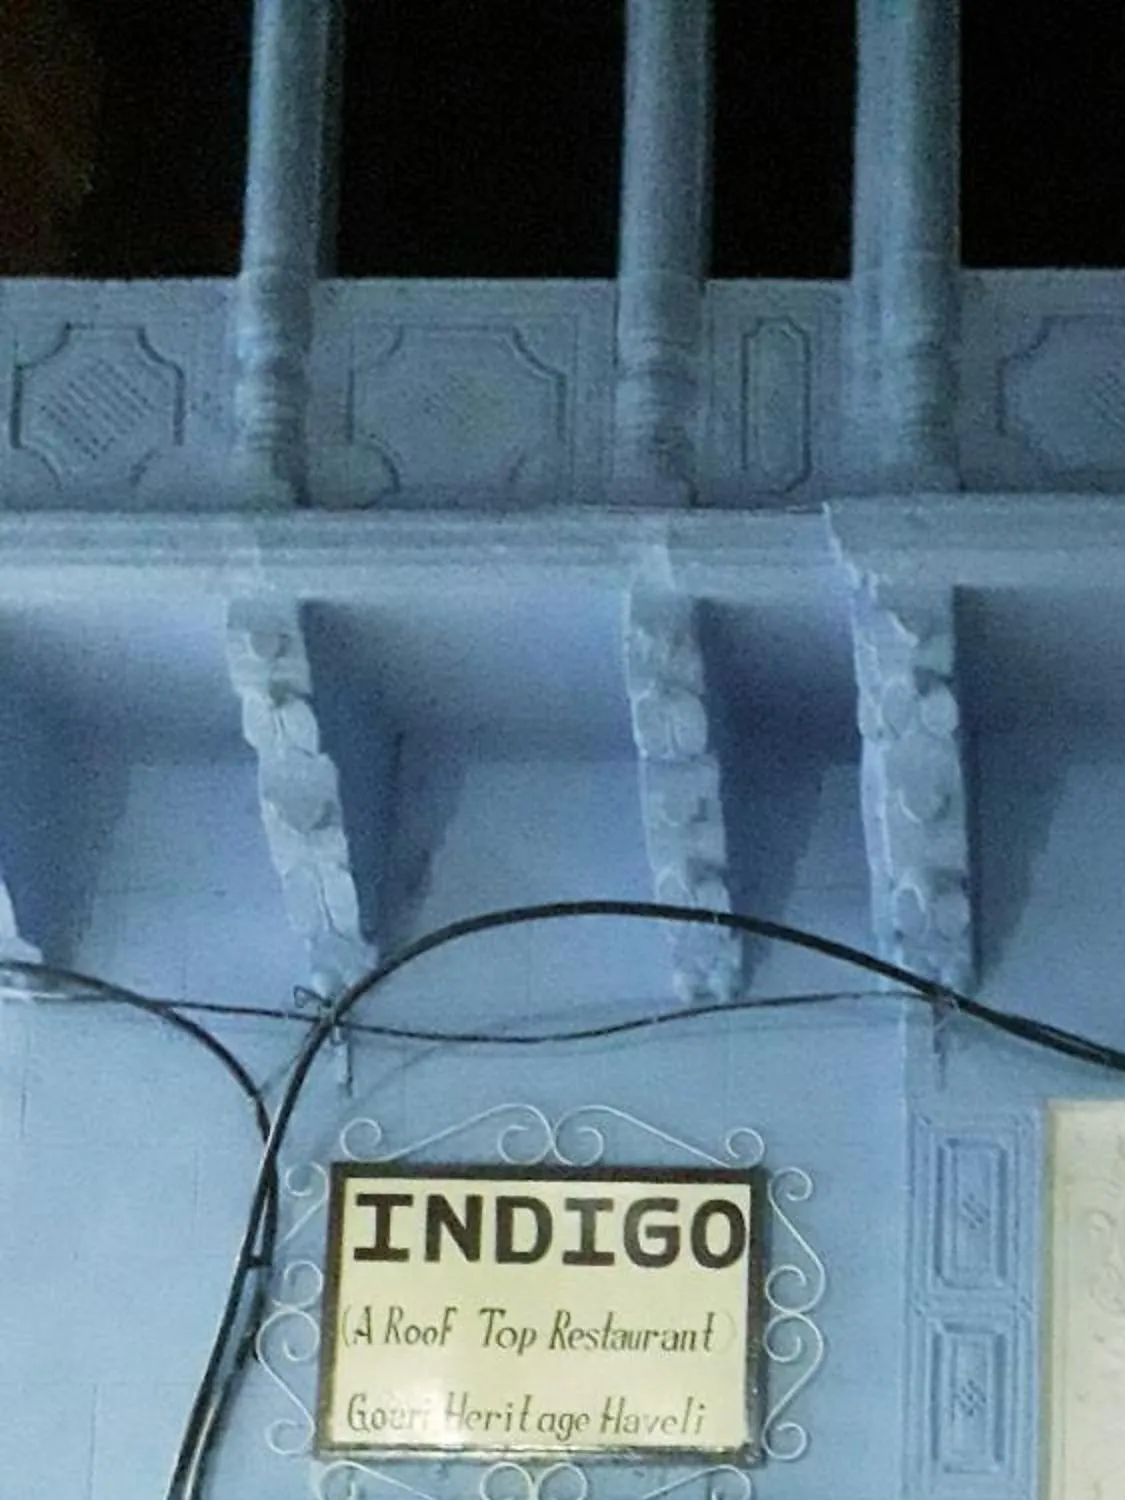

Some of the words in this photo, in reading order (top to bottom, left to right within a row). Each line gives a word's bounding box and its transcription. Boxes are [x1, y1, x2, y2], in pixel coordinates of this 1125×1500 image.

[353, 1192, 747, 1270] INDIGO
[479, 1307, 538, 1355] Top
[445, 1391, 590, 1440] Heritage
[600, 1396, 706, 1436] Haveli
